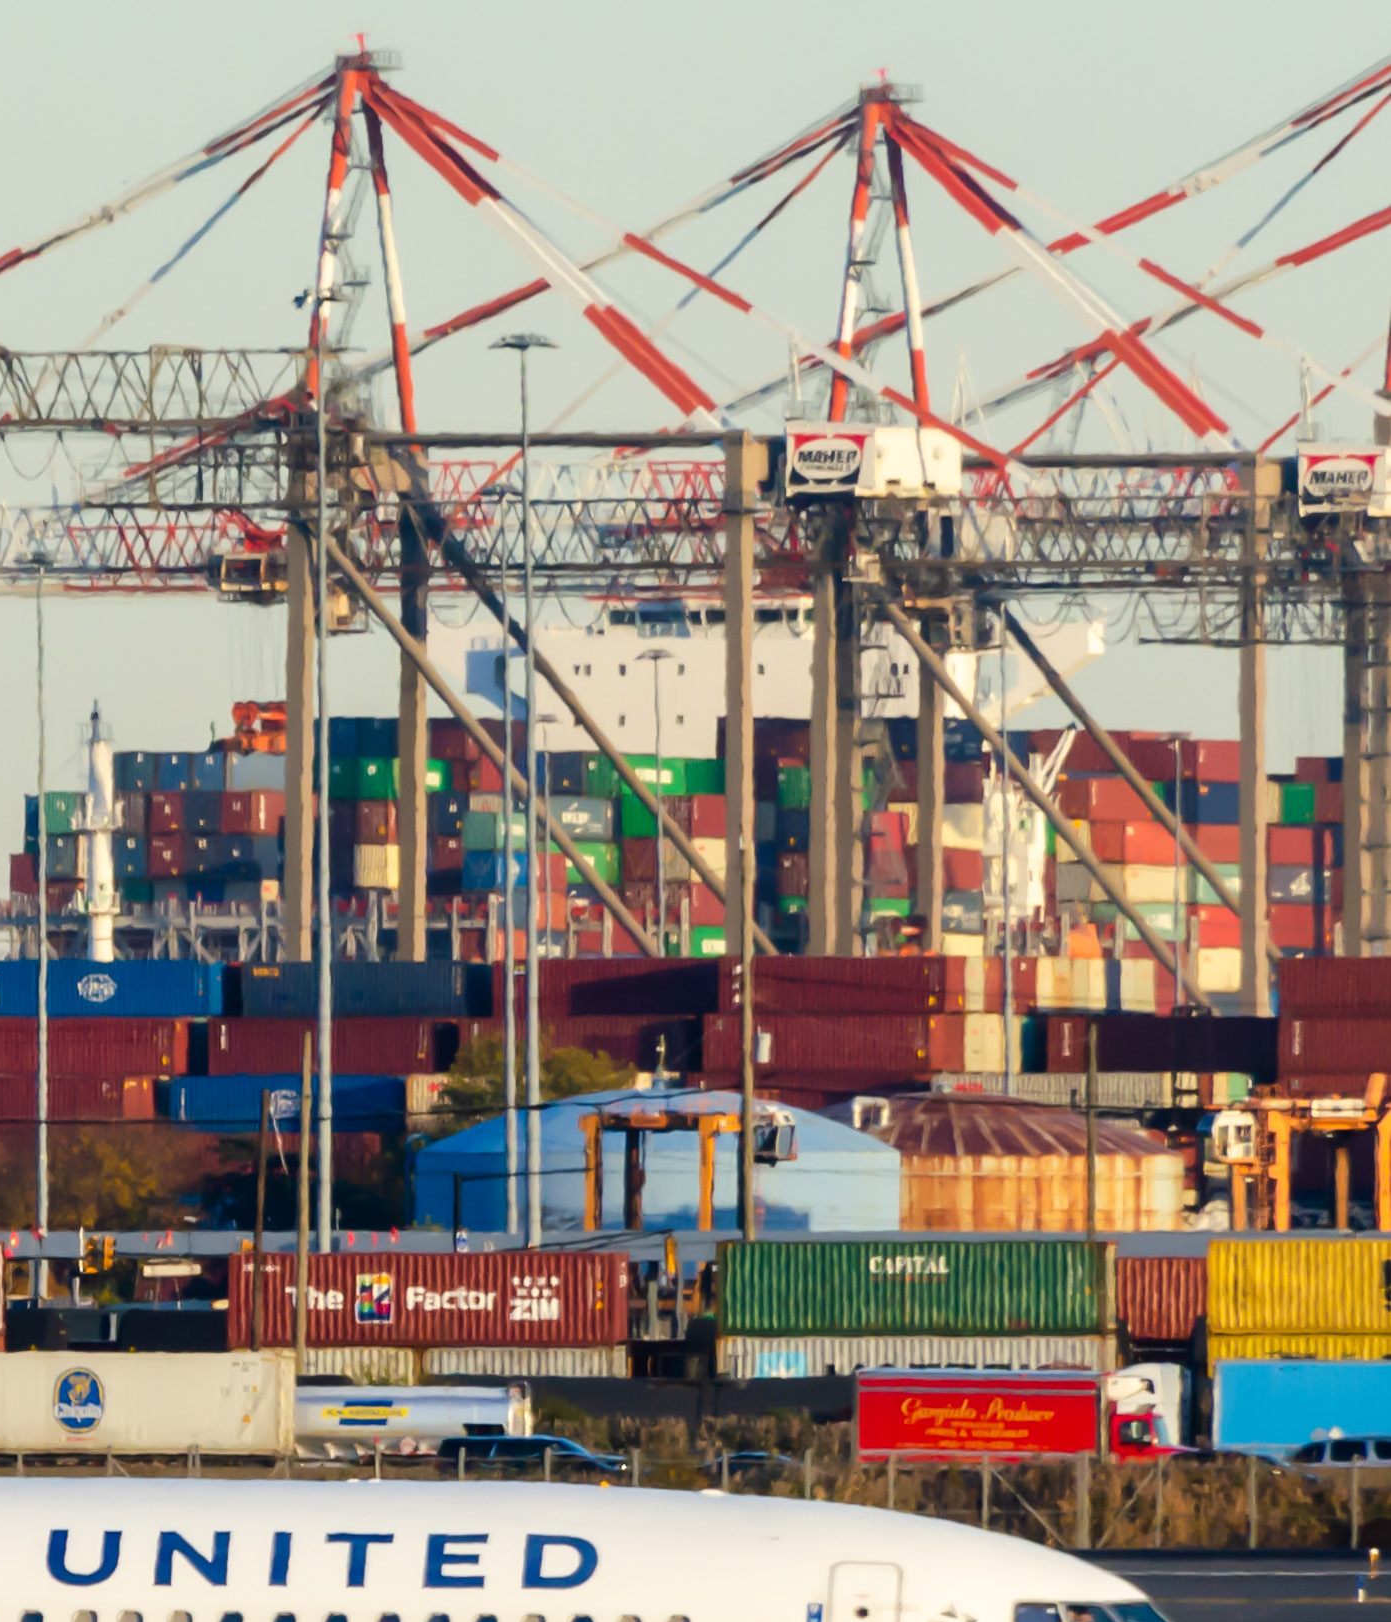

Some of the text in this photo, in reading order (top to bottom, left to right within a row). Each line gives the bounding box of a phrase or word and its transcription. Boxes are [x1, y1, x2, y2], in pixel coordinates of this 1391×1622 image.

[869, 1255, 950, 1274] CAPITAL
[406, 1286, 497, 1312] Factor
[509, 1299, 560, 1321] ZIM
[45, 1529, 599, 1589] UNITED
